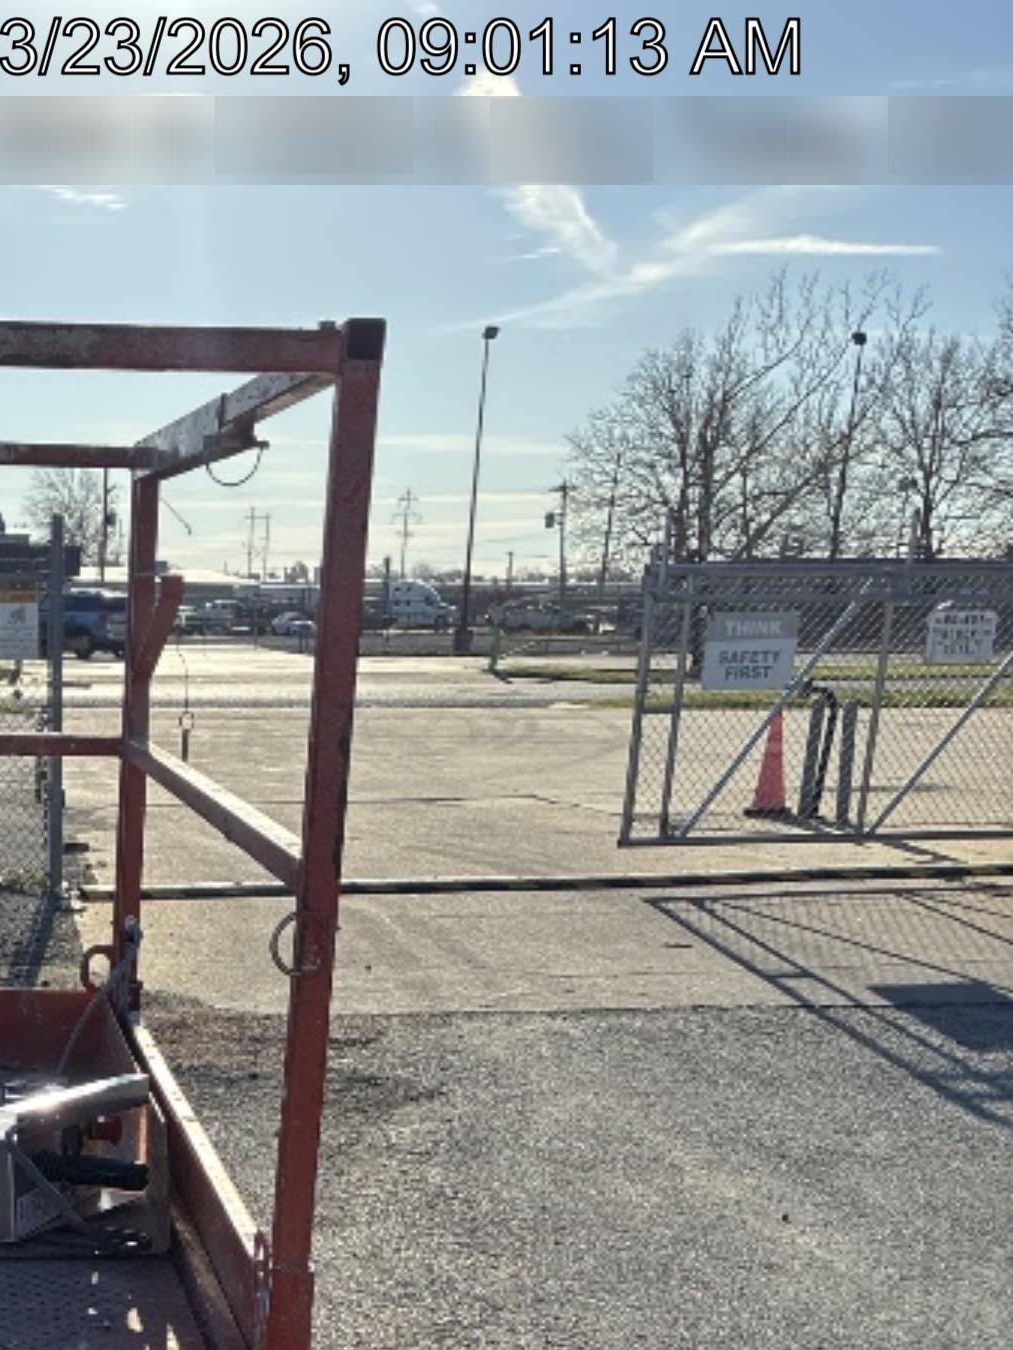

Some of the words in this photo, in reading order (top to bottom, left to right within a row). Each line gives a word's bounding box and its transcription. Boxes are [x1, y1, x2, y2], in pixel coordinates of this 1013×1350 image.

[725, 620, 781, 637] THINK
[718, 650, 781, 665] SAFETY
[724, 665, 773, 681] FIRST
